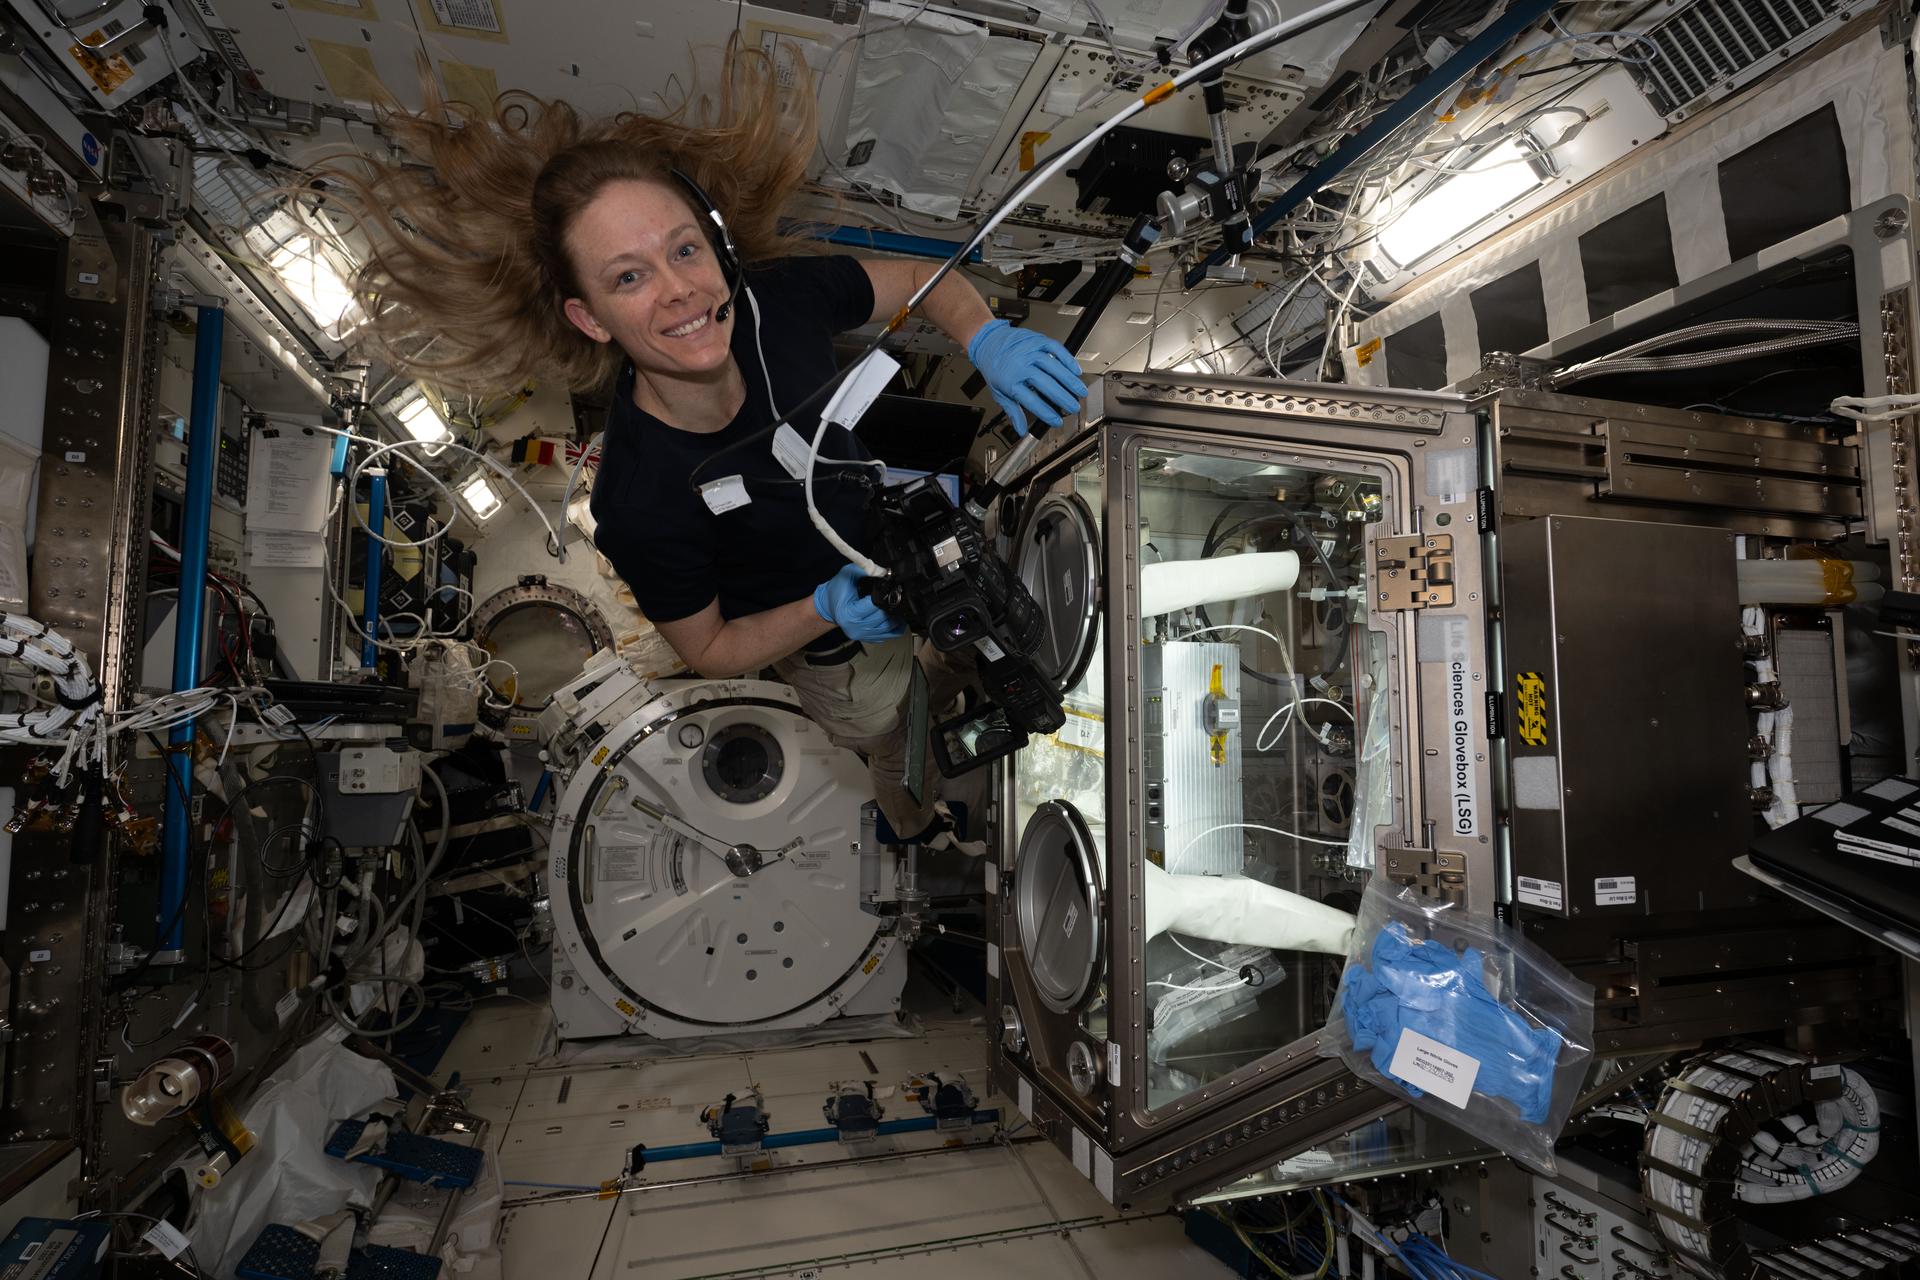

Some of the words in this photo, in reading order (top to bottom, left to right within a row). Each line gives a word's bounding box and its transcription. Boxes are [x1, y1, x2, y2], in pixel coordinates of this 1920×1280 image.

[1451, 652, 1465, 716] Sciences
[1454, 721, 1469, 788] Glovebox
[1454, 794, 1472, 834] (LSG)
[1417, 1046, 1430, 1055] Large
